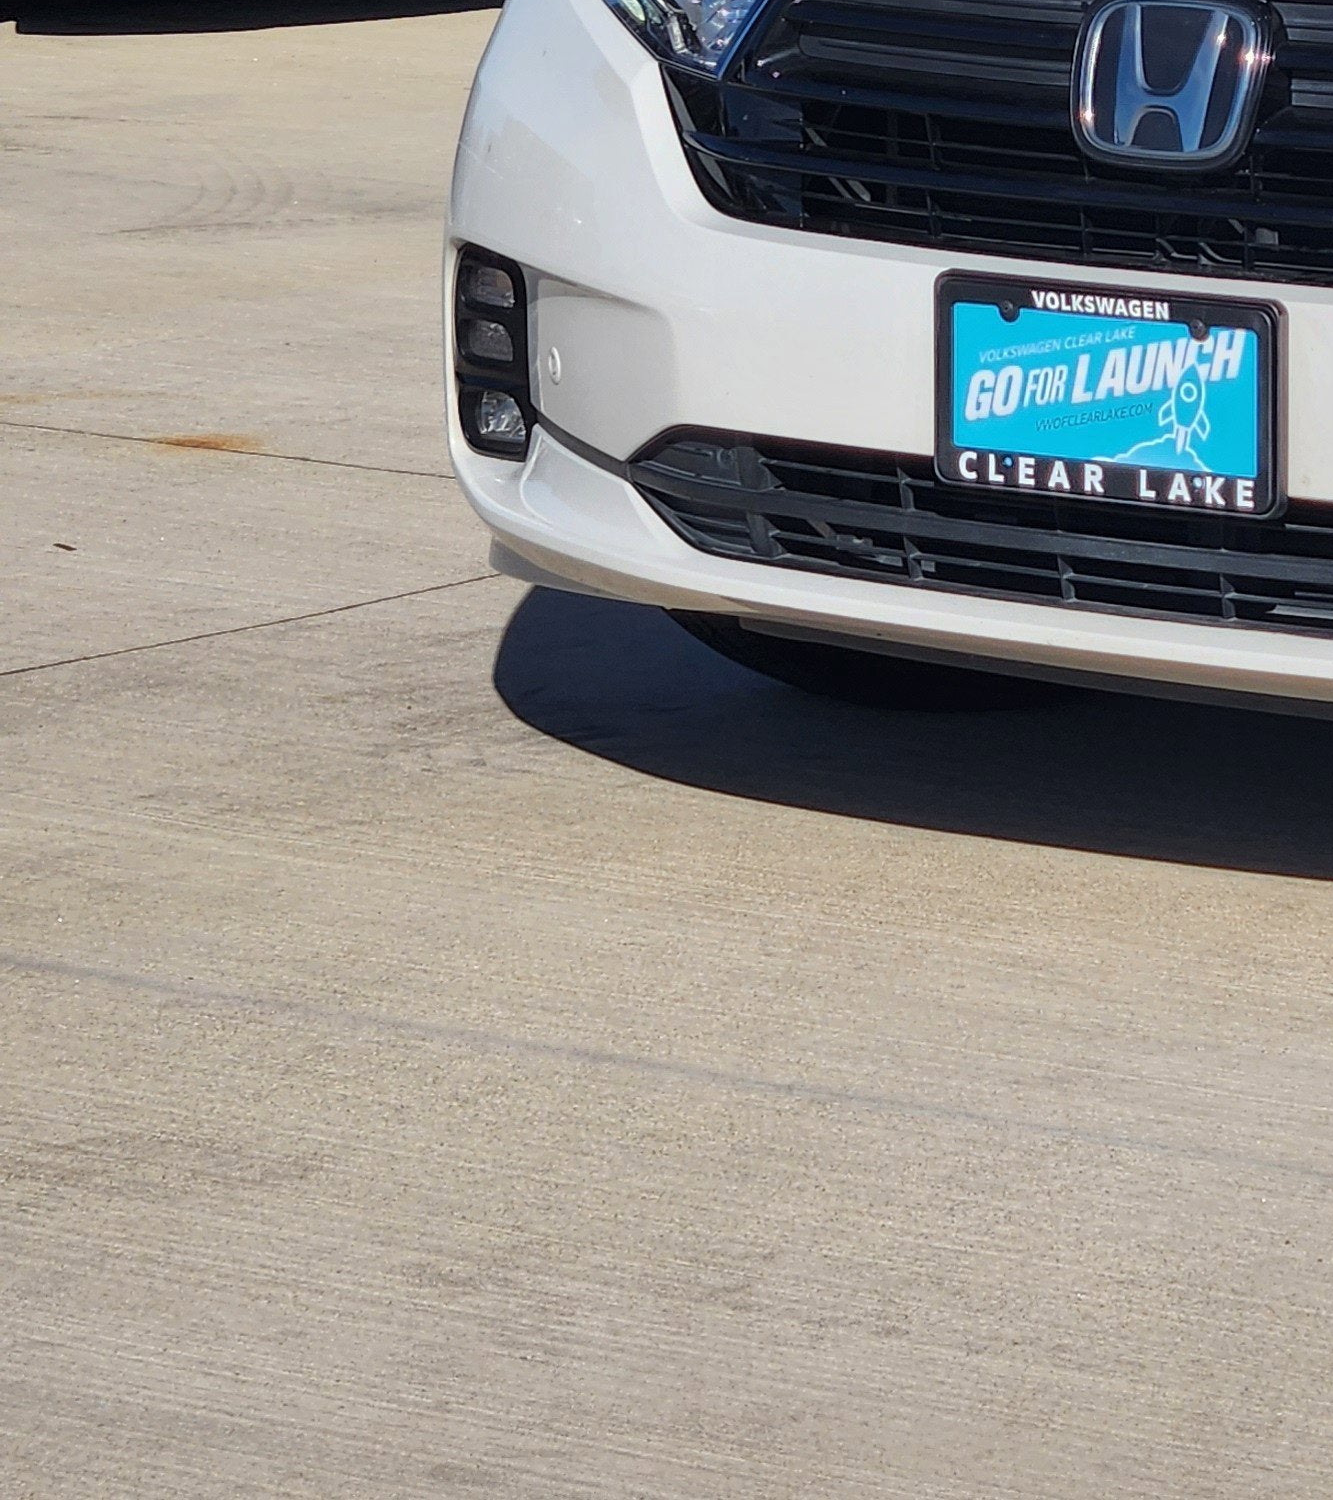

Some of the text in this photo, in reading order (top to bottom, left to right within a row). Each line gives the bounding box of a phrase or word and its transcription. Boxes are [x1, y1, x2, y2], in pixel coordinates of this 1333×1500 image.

[1031, 290, 1169, 321] VOLKSWAGEN
[979, 325, 1137, 364] VOLKSWAGEN CLEAR LAKE
[964, 328, 1247, 422] GO FOR LAUNCH
[1035, 402, 1154, 432] VWOFCLEARLAKE.COM
[958, 450, 1256, 510] CLEAR LAKE
